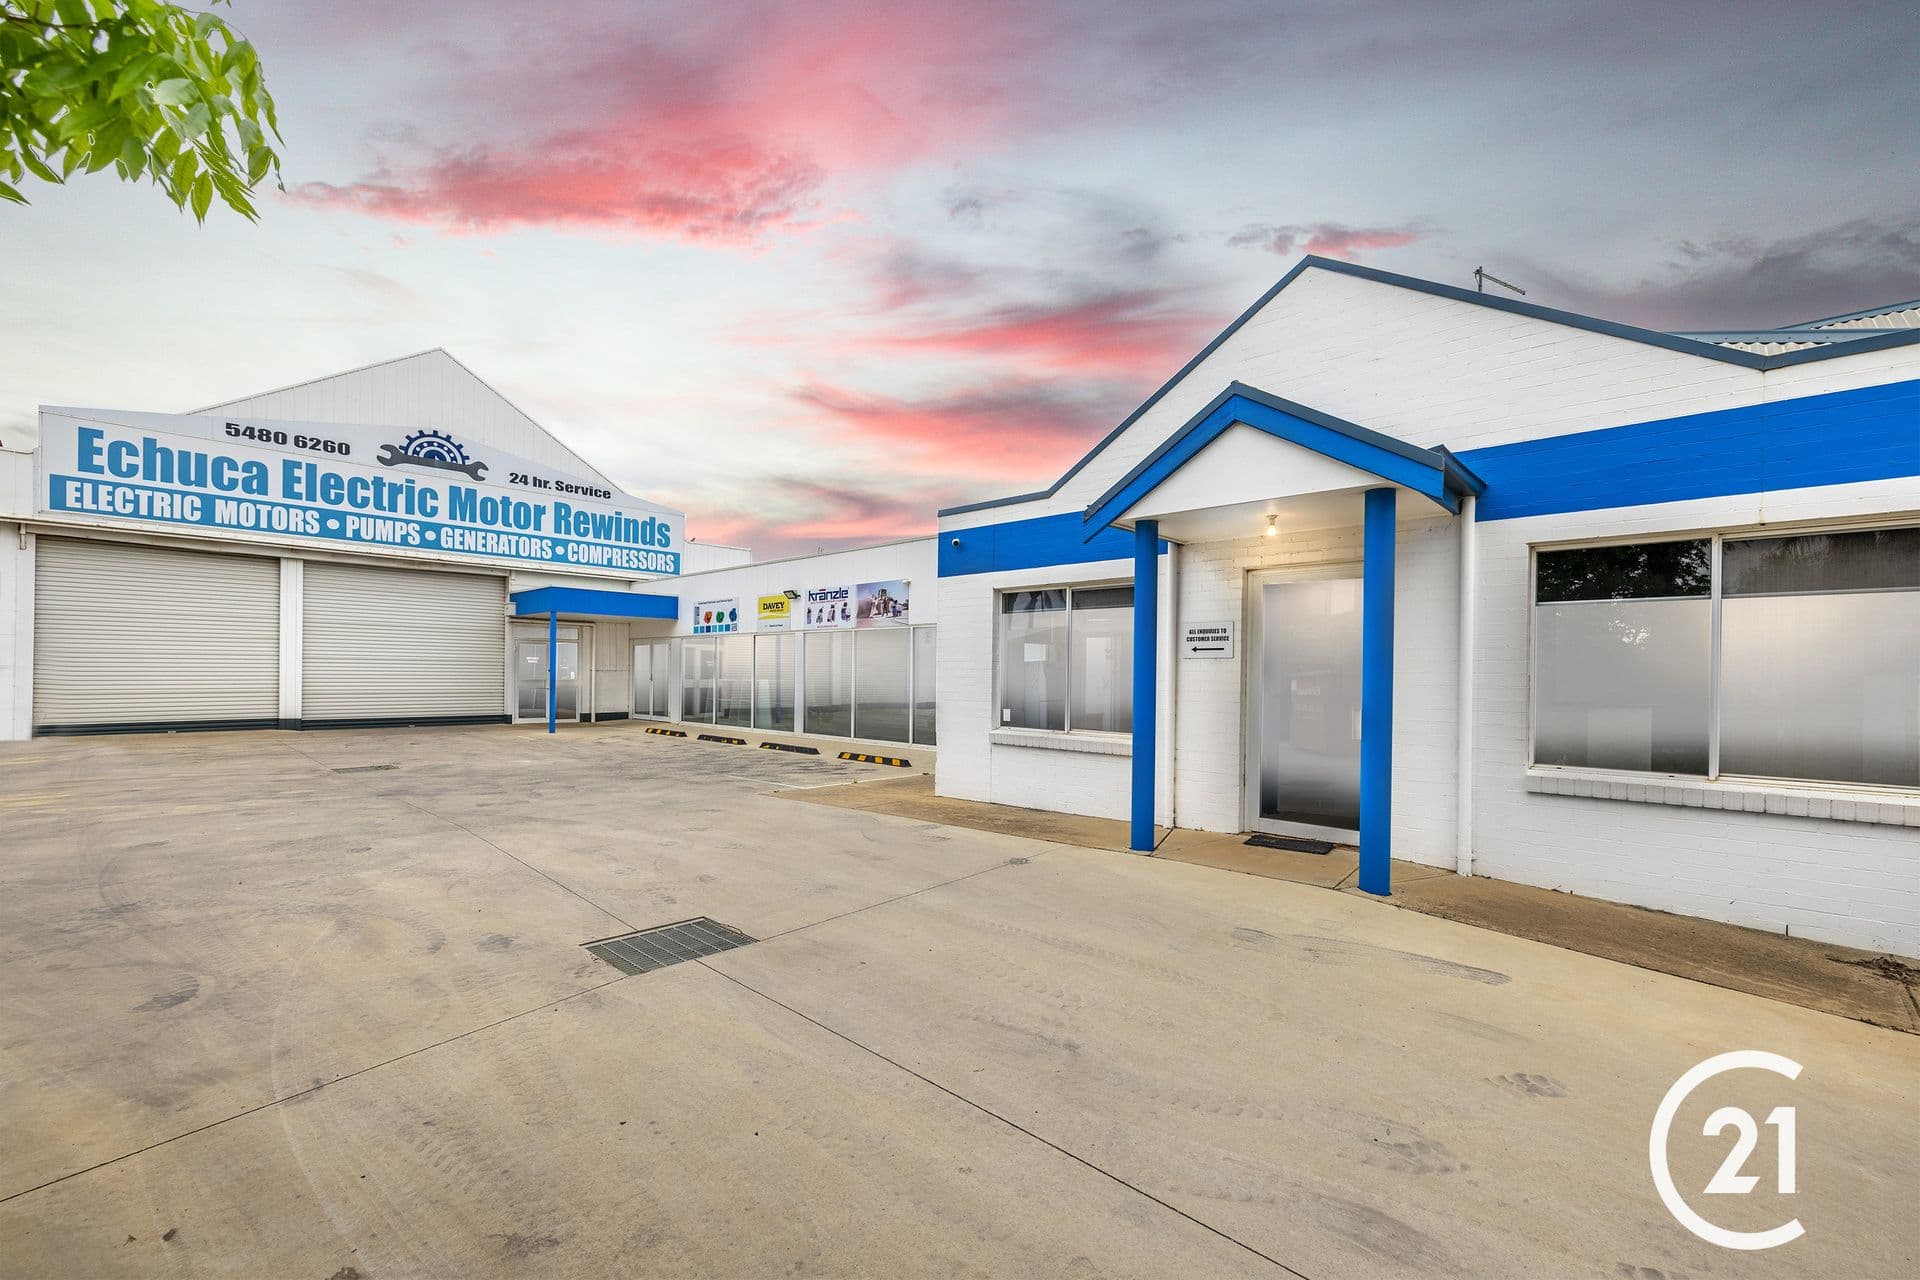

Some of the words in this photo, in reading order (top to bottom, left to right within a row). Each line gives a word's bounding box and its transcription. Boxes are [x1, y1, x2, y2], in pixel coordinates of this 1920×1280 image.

[225, 422, 287, 445] 5480
[294, 435, 351, 455] 6260
[78, 426, 269, 497] Echuca
[282, 459, 439, 518] Electric
[449, 485, 546, 532] Motor
[554, 501, 671, 548] Rewinds
[509, 472, 529, 486] 24
[532, 476, 552, 490] hr.
[555, 480, 612, 499] Service
[65, 480, 201, 521] ELECTRIC
[215, 499, 320, 534] MOTORS
[346, 515, 421, 545] PUMPS
[440, 527, 552, 559] GENERATORS
[567, 542, 675, 574] COMPRESSORS
[762, 601, 785, 610] DAVEY
